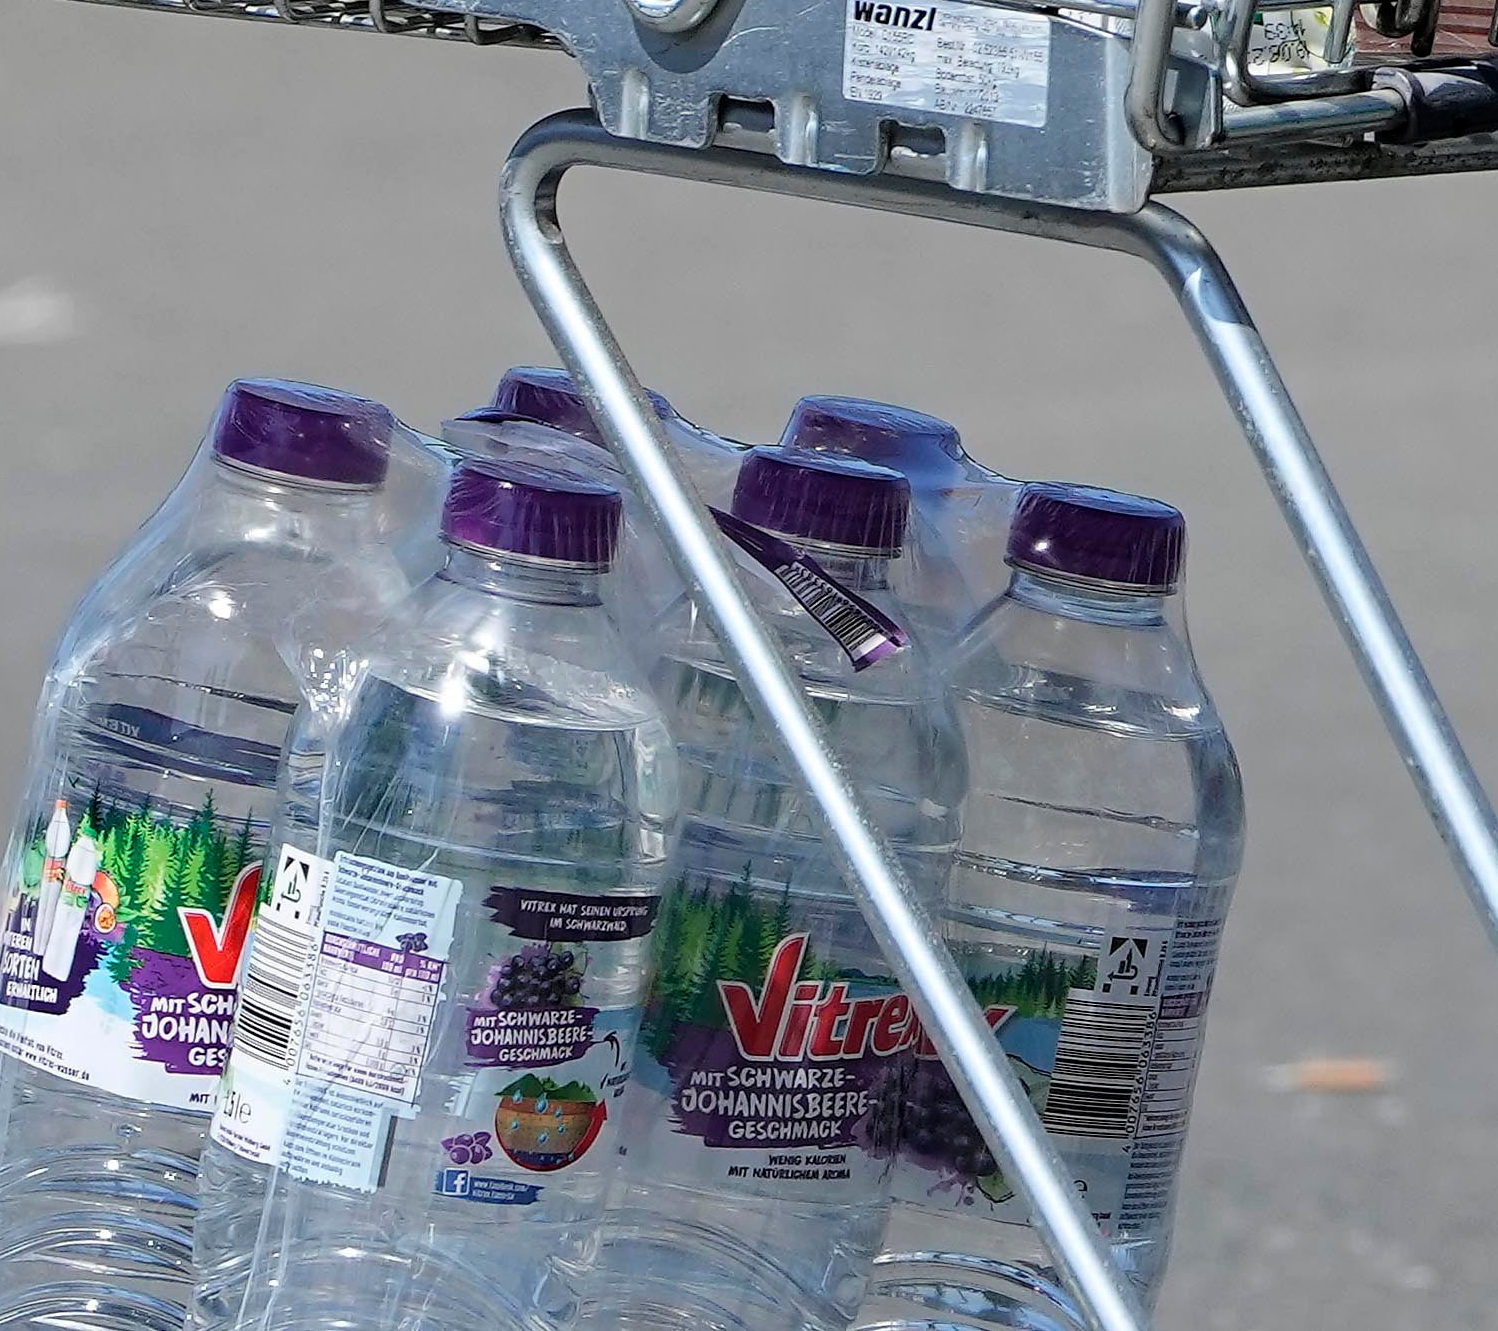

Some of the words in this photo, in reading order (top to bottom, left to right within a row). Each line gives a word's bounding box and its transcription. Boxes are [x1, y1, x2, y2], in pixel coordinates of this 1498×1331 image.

[854, 0, 937, 32] wanzl
[559, 902, 578, 916] HAT
[151, 995, 186, 1015] MIT
[716, 932, 1018, 1062] Vitre
[473, 1015, 498, 1029] MIT
[497, 1008, 583, 1027] SCHWARZE-
[470, 1024, 594, 1046] JOHANNISBEERE-
[498, 1045, 574, 1063] GESCHMACK
[690, 1069, 725, 1088] MIT
[728, 1066, 856, 1090] SCHWARZE-
[189, 1091, 211, 1105] MIT
[680, 1087, 880, 1119] JOHANNISBEERE-
[727, 1119, 843, 1141] GESCHMACK
[768, 1153, 802, 1167] WENIG
[727, 1165, 750, 1180] MIT
